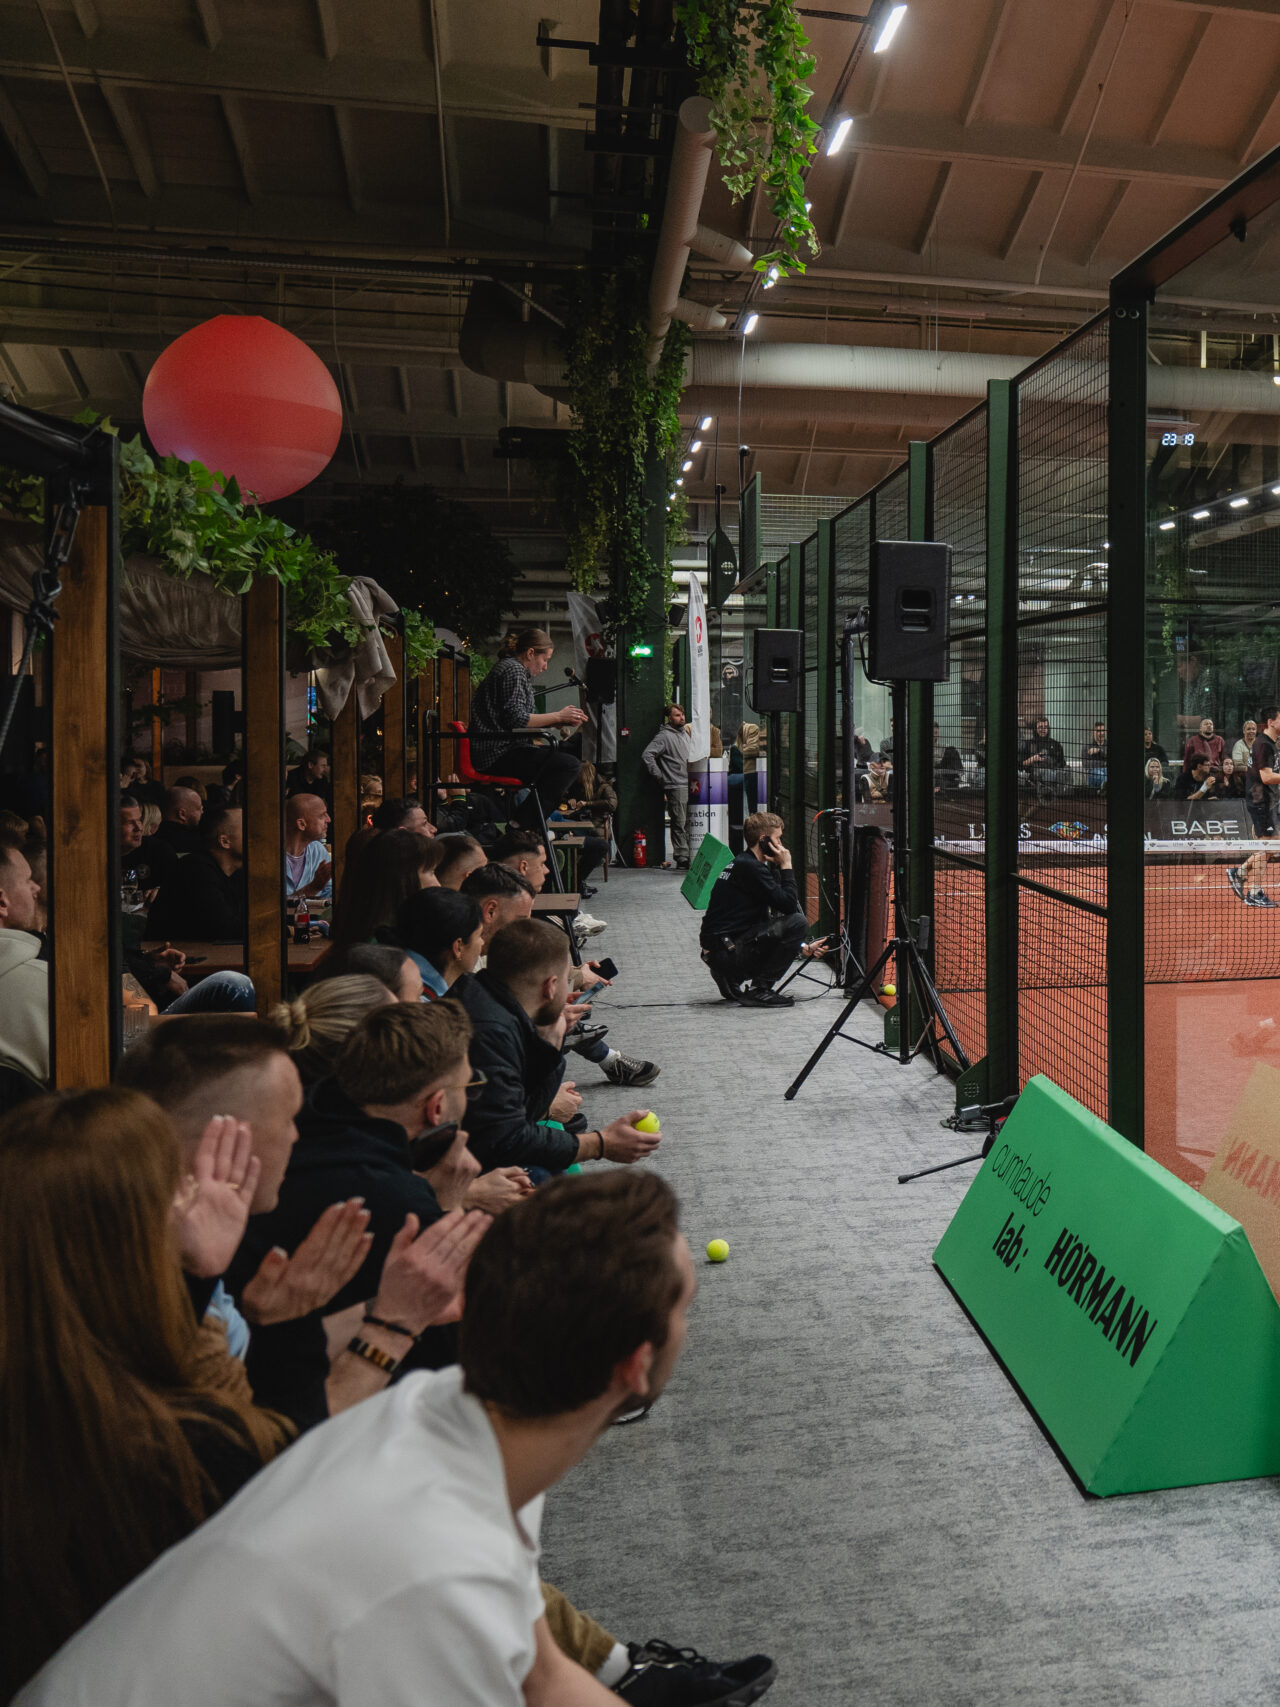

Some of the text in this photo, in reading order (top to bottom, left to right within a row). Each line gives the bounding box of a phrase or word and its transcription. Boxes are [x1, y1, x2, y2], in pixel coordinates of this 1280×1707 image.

[1171, 820, 1240, 835] BABE
[991, 1143, 1051, 1217] cumlaude
[992, 1212, 1158, 1367] lab: HÖRMANN
